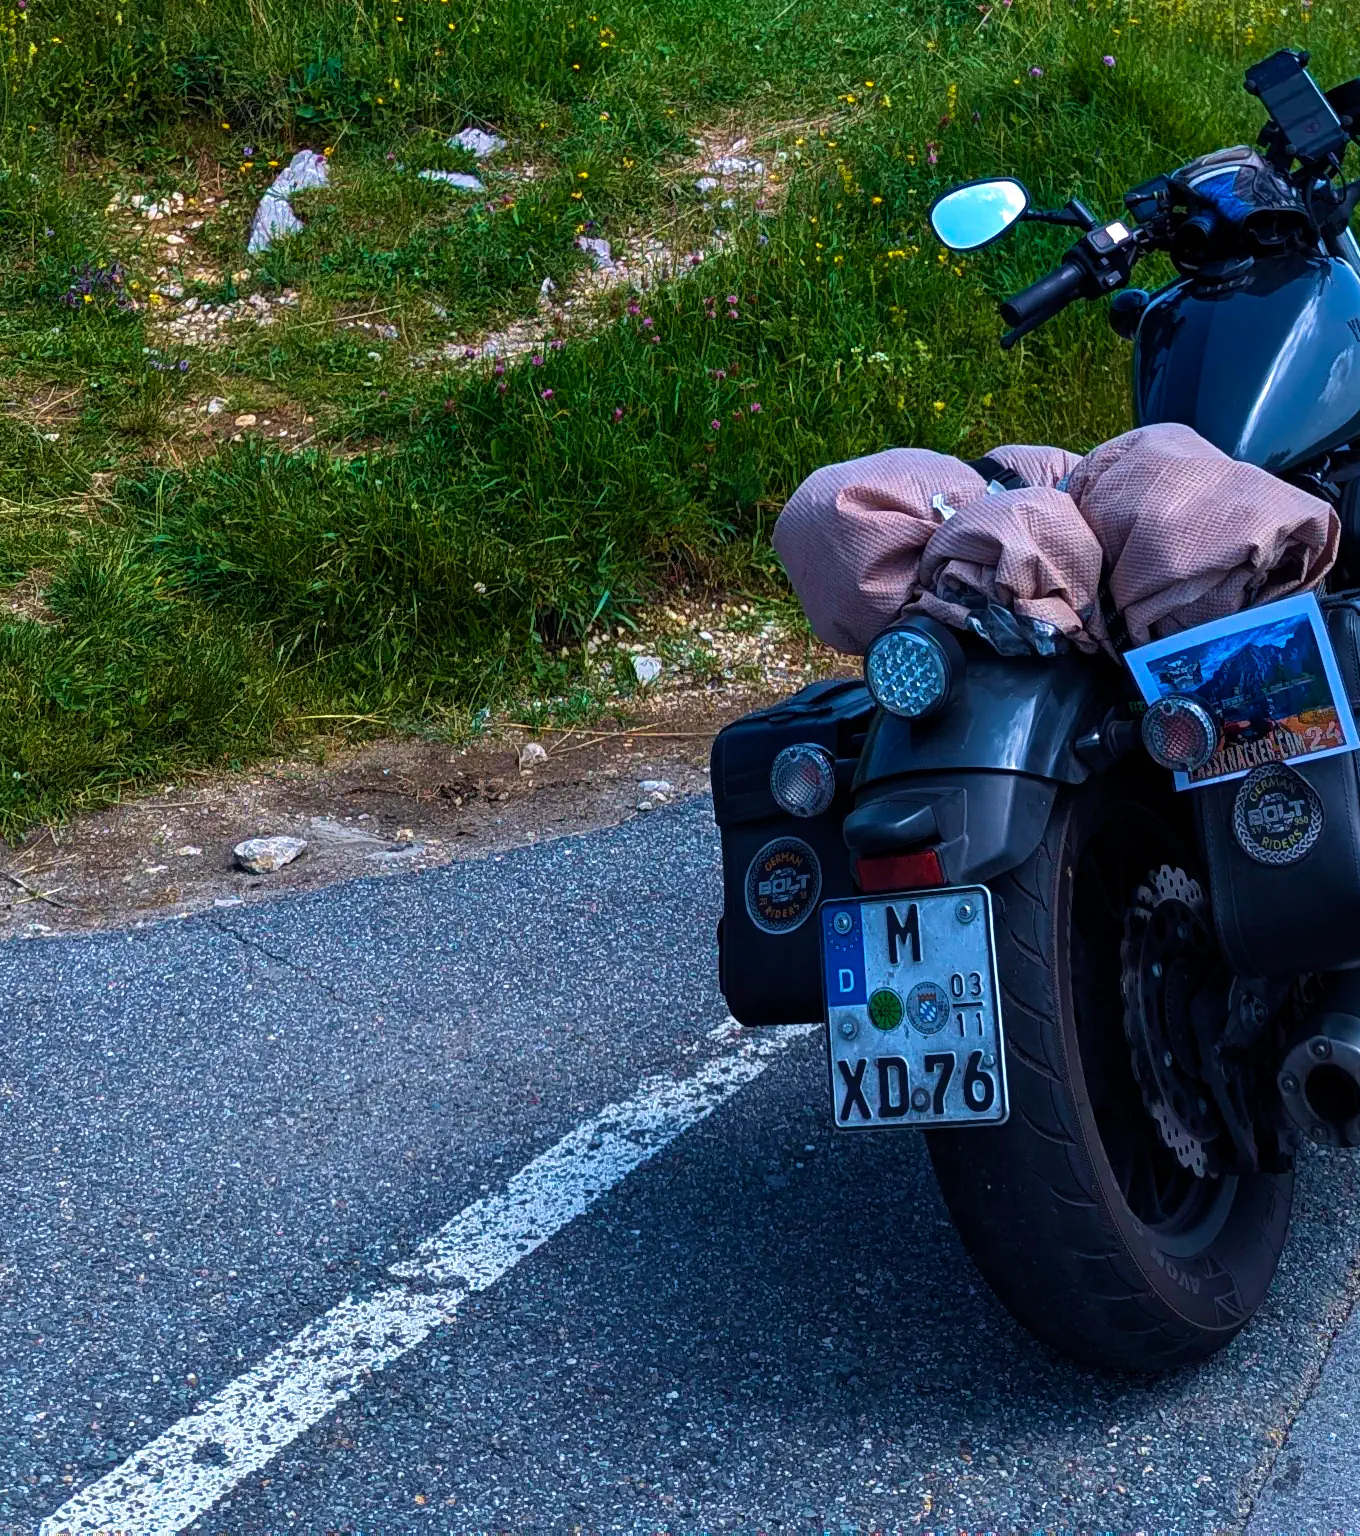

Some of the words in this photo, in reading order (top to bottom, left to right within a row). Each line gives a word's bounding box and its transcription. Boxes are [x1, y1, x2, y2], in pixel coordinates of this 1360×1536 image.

[1304, 720, 1344, 751] 24
[1249, 777, 1297, 802] GERMAN
[1248, 799, 1305, 825] BOLT
[1261, 829, 1303, 850] RIDERS
[764, 852, 803, 872] GERMAN
[759, 874, 810, 895] BOLT
[765, 903, 800, 919] RIDERS
[886, 903, 923, 964] M
[838, 968, 855, 993] D
[951, 971, 982, 998] 03
[957, 1011, 983, 1038] 11
[837, 1056, 910, 1121] XD
[925, 1050, 995, 1115] 76
